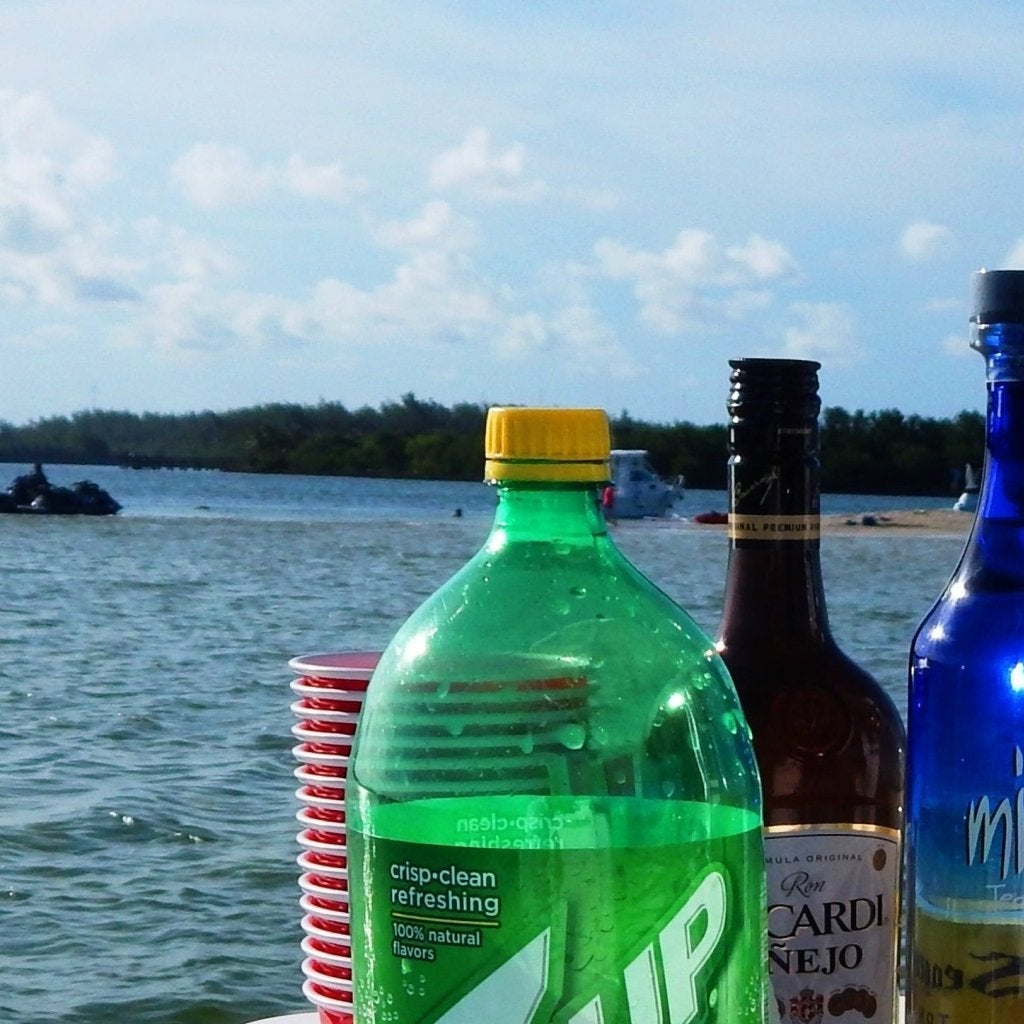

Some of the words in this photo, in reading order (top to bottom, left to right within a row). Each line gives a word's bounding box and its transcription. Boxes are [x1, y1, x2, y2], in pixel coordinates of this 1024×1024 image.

[806, 854, 863, 863] ORIGINAL
[780, 871, 825, 897] Ron
[391, 887, 499, 916] refreshing
[393, 922, 424, 940] 100%
[428, 930, 480, 945] natural
[393, 940, 434, 960] flavors
